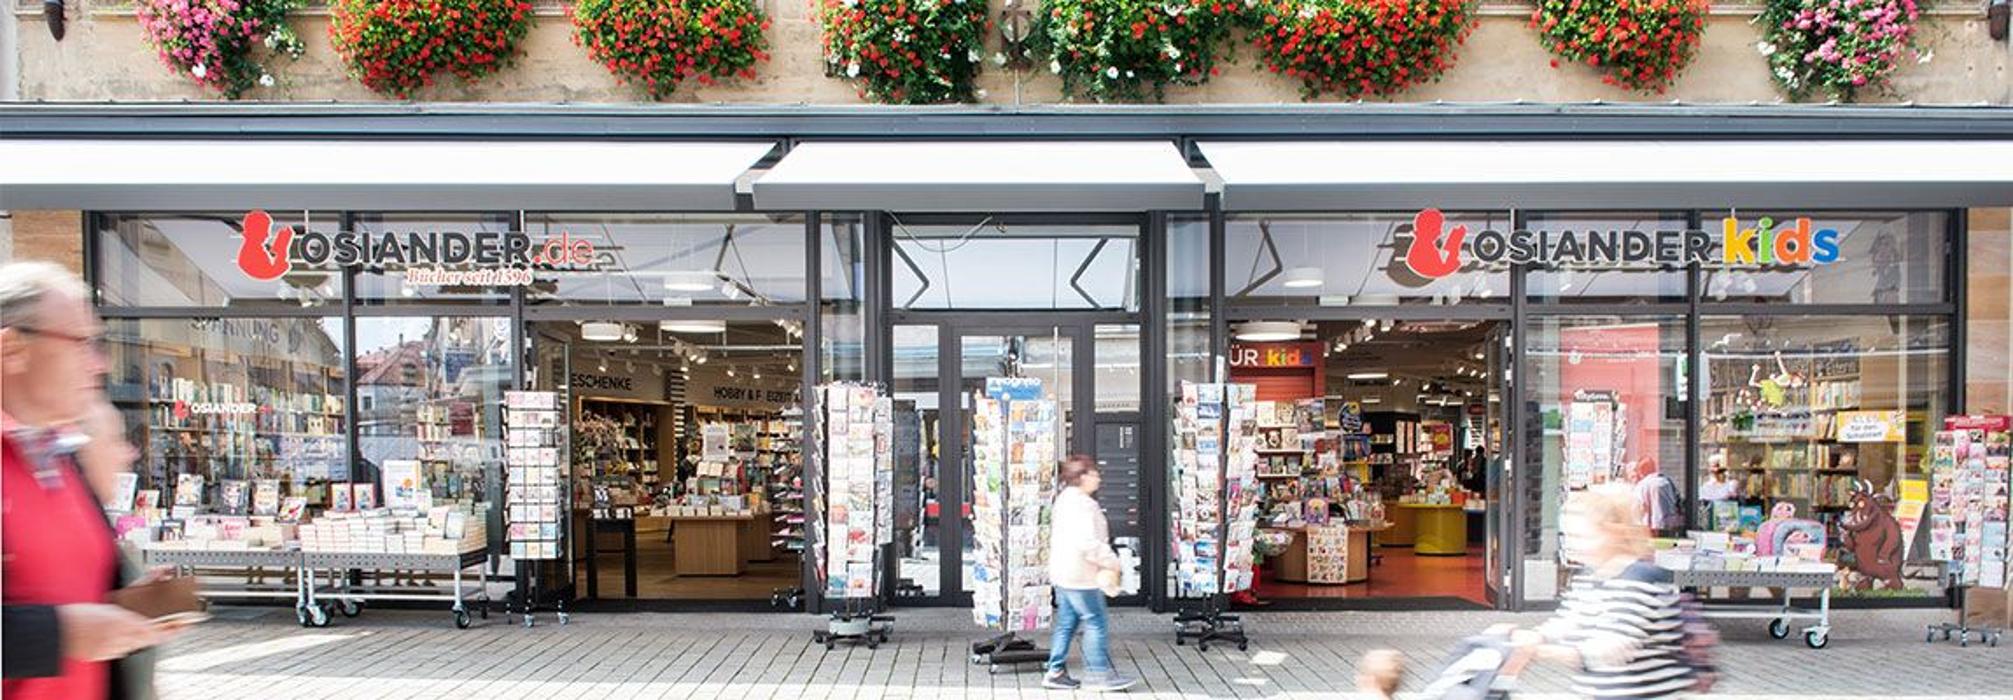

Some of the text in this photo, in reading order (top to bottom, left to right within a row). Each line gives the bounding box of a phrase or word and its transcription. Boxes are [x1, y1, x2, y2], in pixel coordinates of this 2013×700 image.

[300, 230, 593, 265] OSIANDER.de
[1473, 216, 1840, 264] OSIANDER kids
[407, 267, 532, 285] Bücher seit 1596
